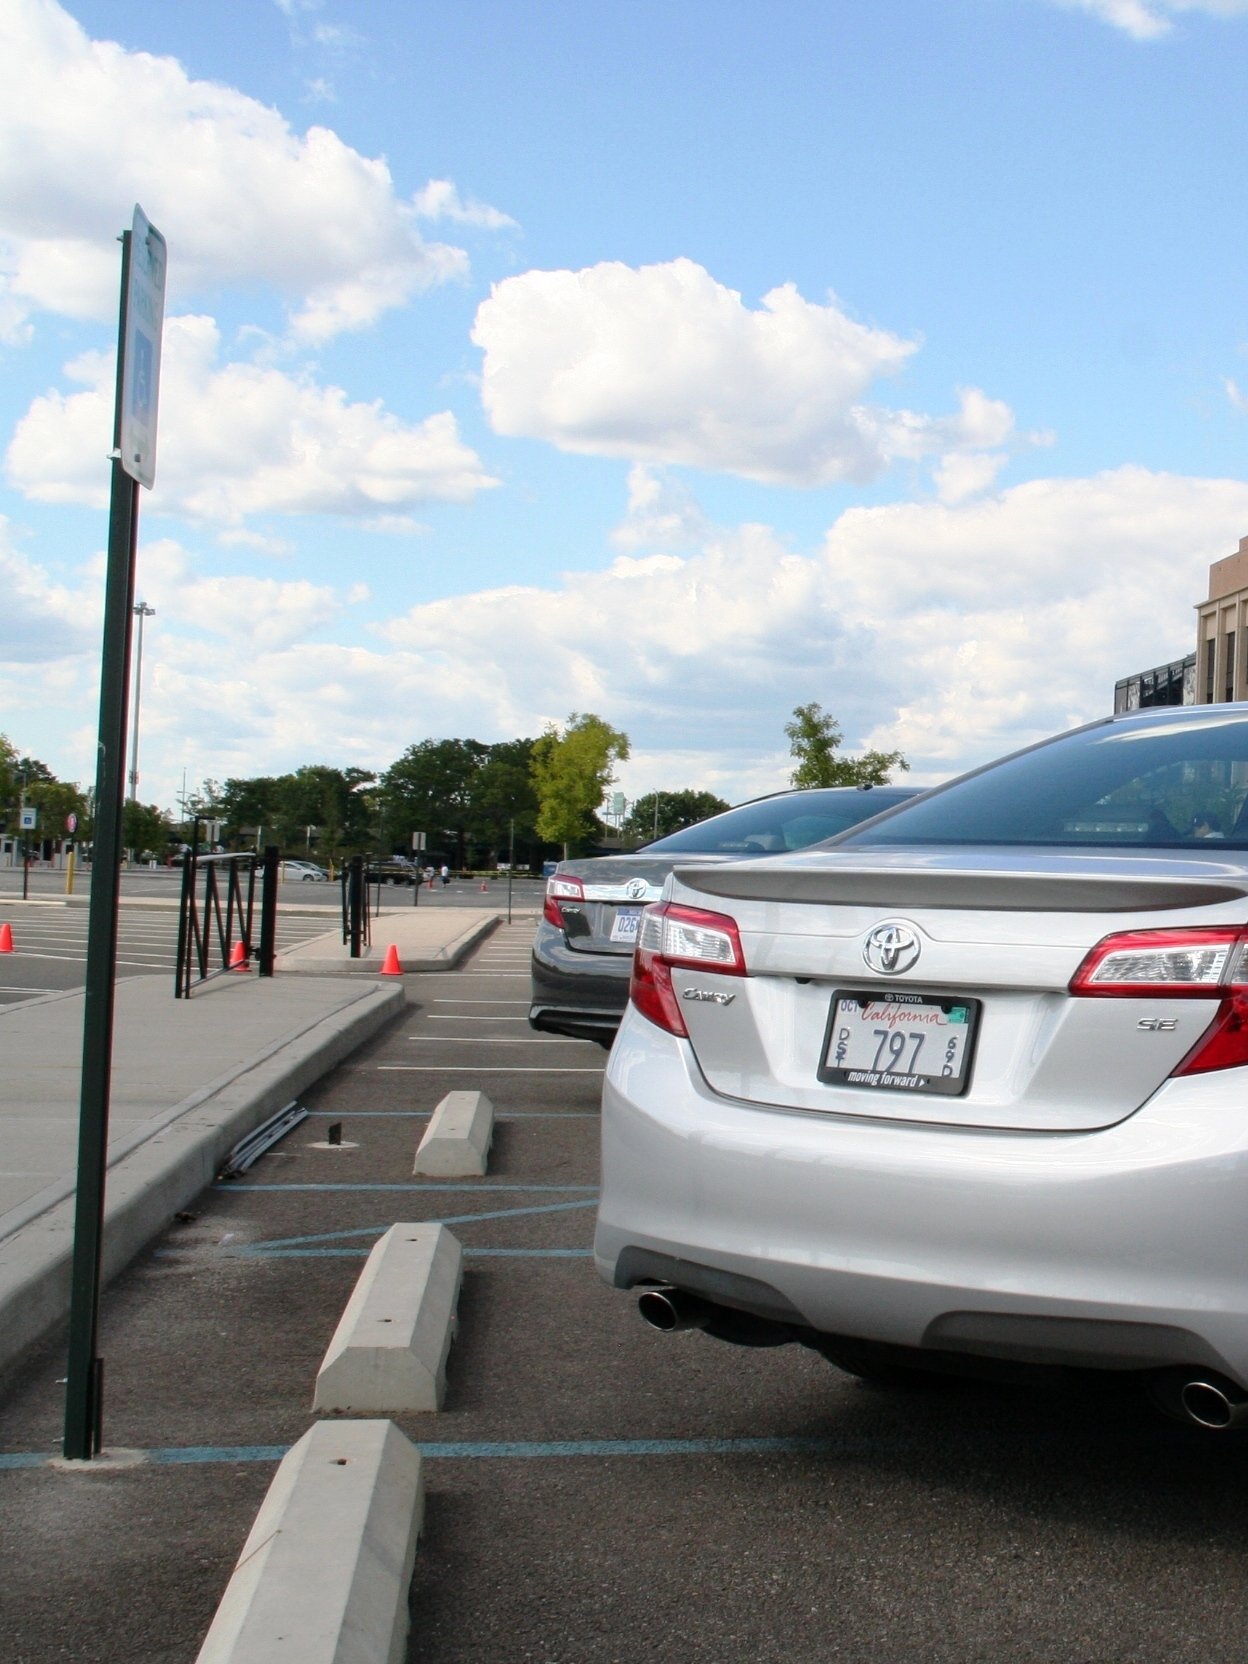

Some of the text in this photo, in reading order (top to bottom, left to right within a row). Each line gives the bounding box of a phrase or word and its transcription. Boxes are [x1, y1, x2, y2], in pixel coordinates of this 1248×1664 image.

[840, 1000, 858, 1013] OCT
[894, 994, 923, 1004] TOYOTA
[861, 1001, 947, 1029] California
[1136, 1017, 1179, 1031] SE
[871, 1029, 926, 1074] 797
[848, 1071, 918, 1088] moving forward
